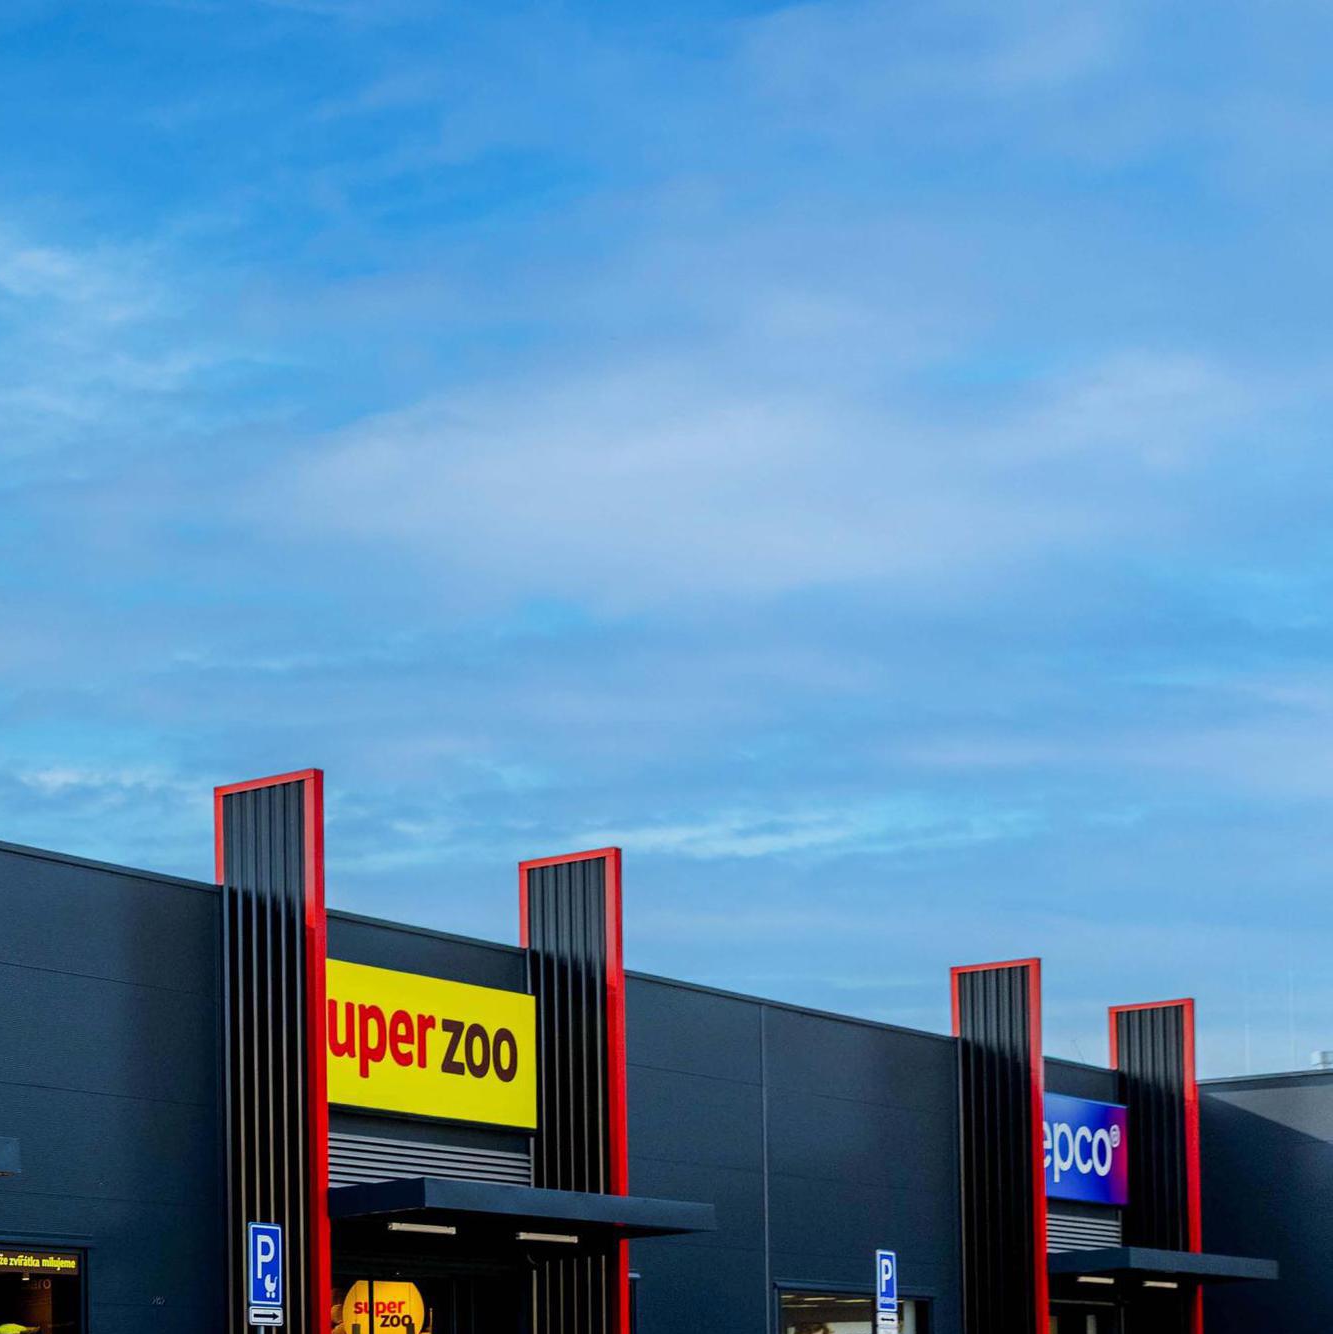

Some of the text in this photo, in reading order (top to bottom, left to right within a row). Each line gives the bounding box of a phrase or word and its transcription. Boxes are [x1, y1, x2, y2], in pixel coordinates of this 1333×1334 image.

[41, 1256, 76, 1271] milujeme
[256, 1234, 275, 1279] P
[881, 1258, 893, 1293] P
[379, 1315, 413, 1328] zoo
